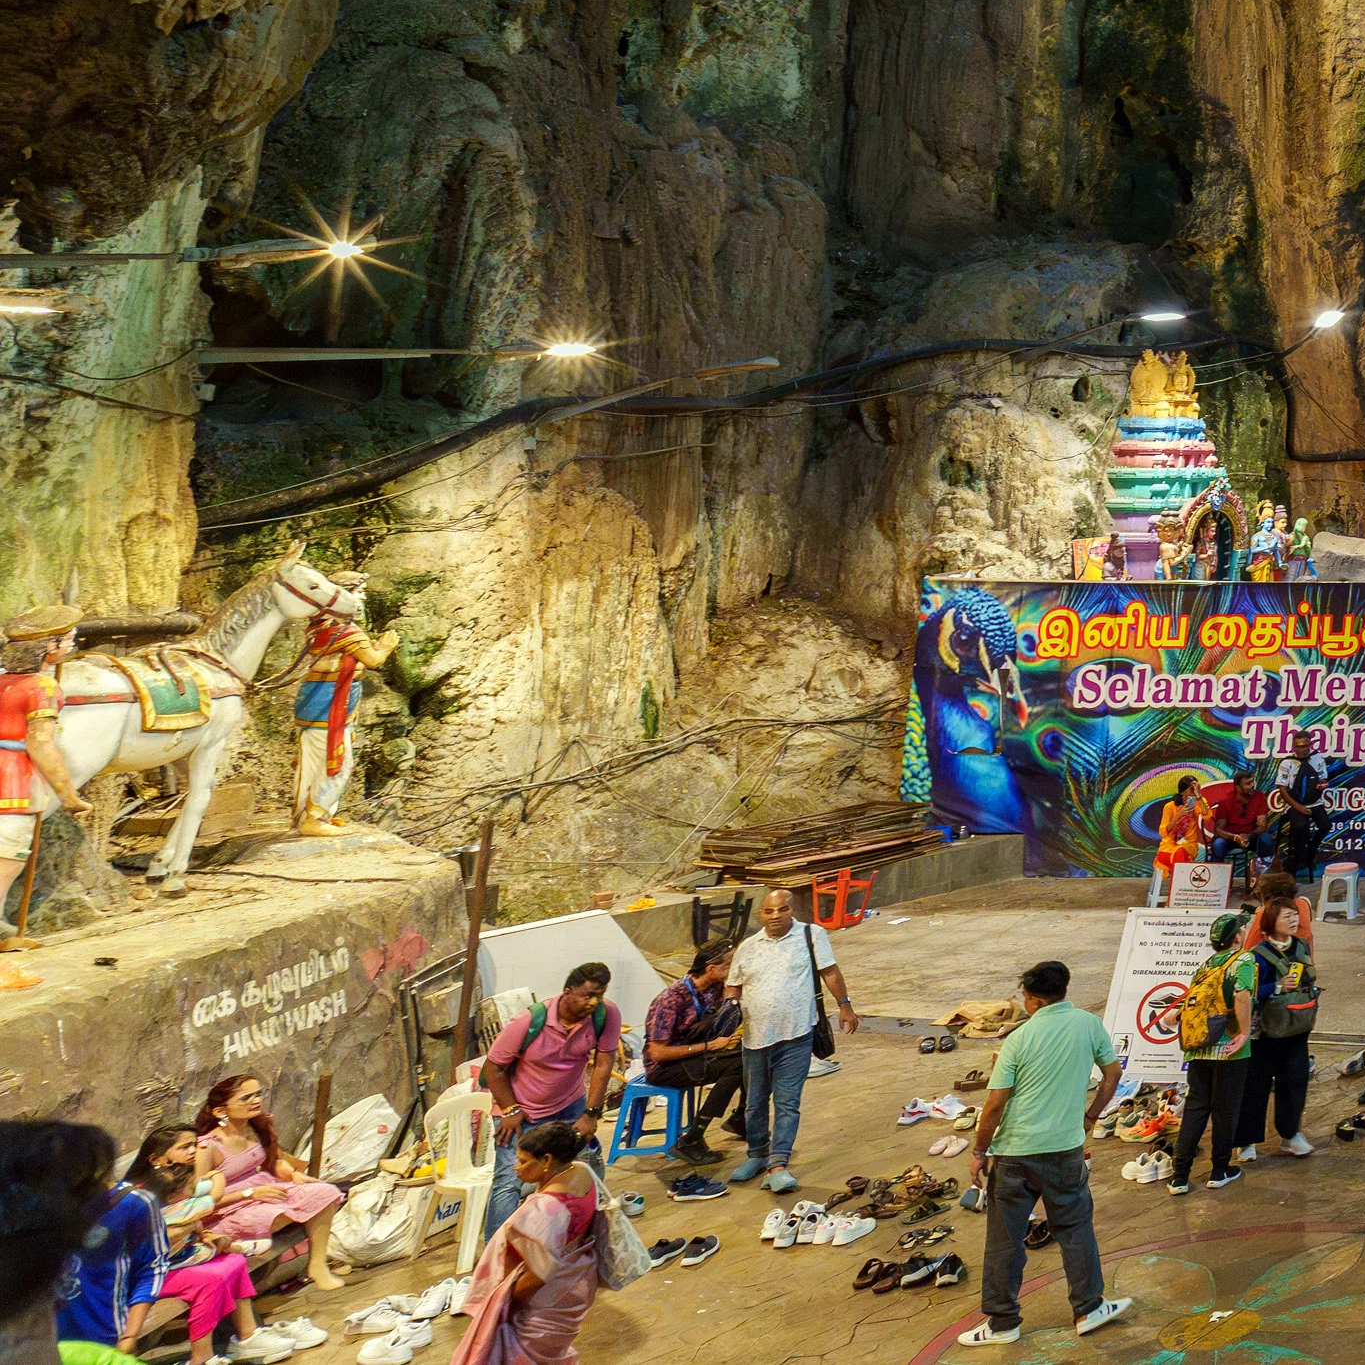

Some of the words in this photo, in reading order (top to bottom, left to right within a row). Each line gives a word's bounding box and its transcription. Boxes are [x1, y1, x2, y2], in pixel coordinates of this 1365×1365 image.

[1036, 601, 1189, 659] இனிய
[1076, 664, 1265, 707] Selamat
[284, 989, 348, 1037] WASH
